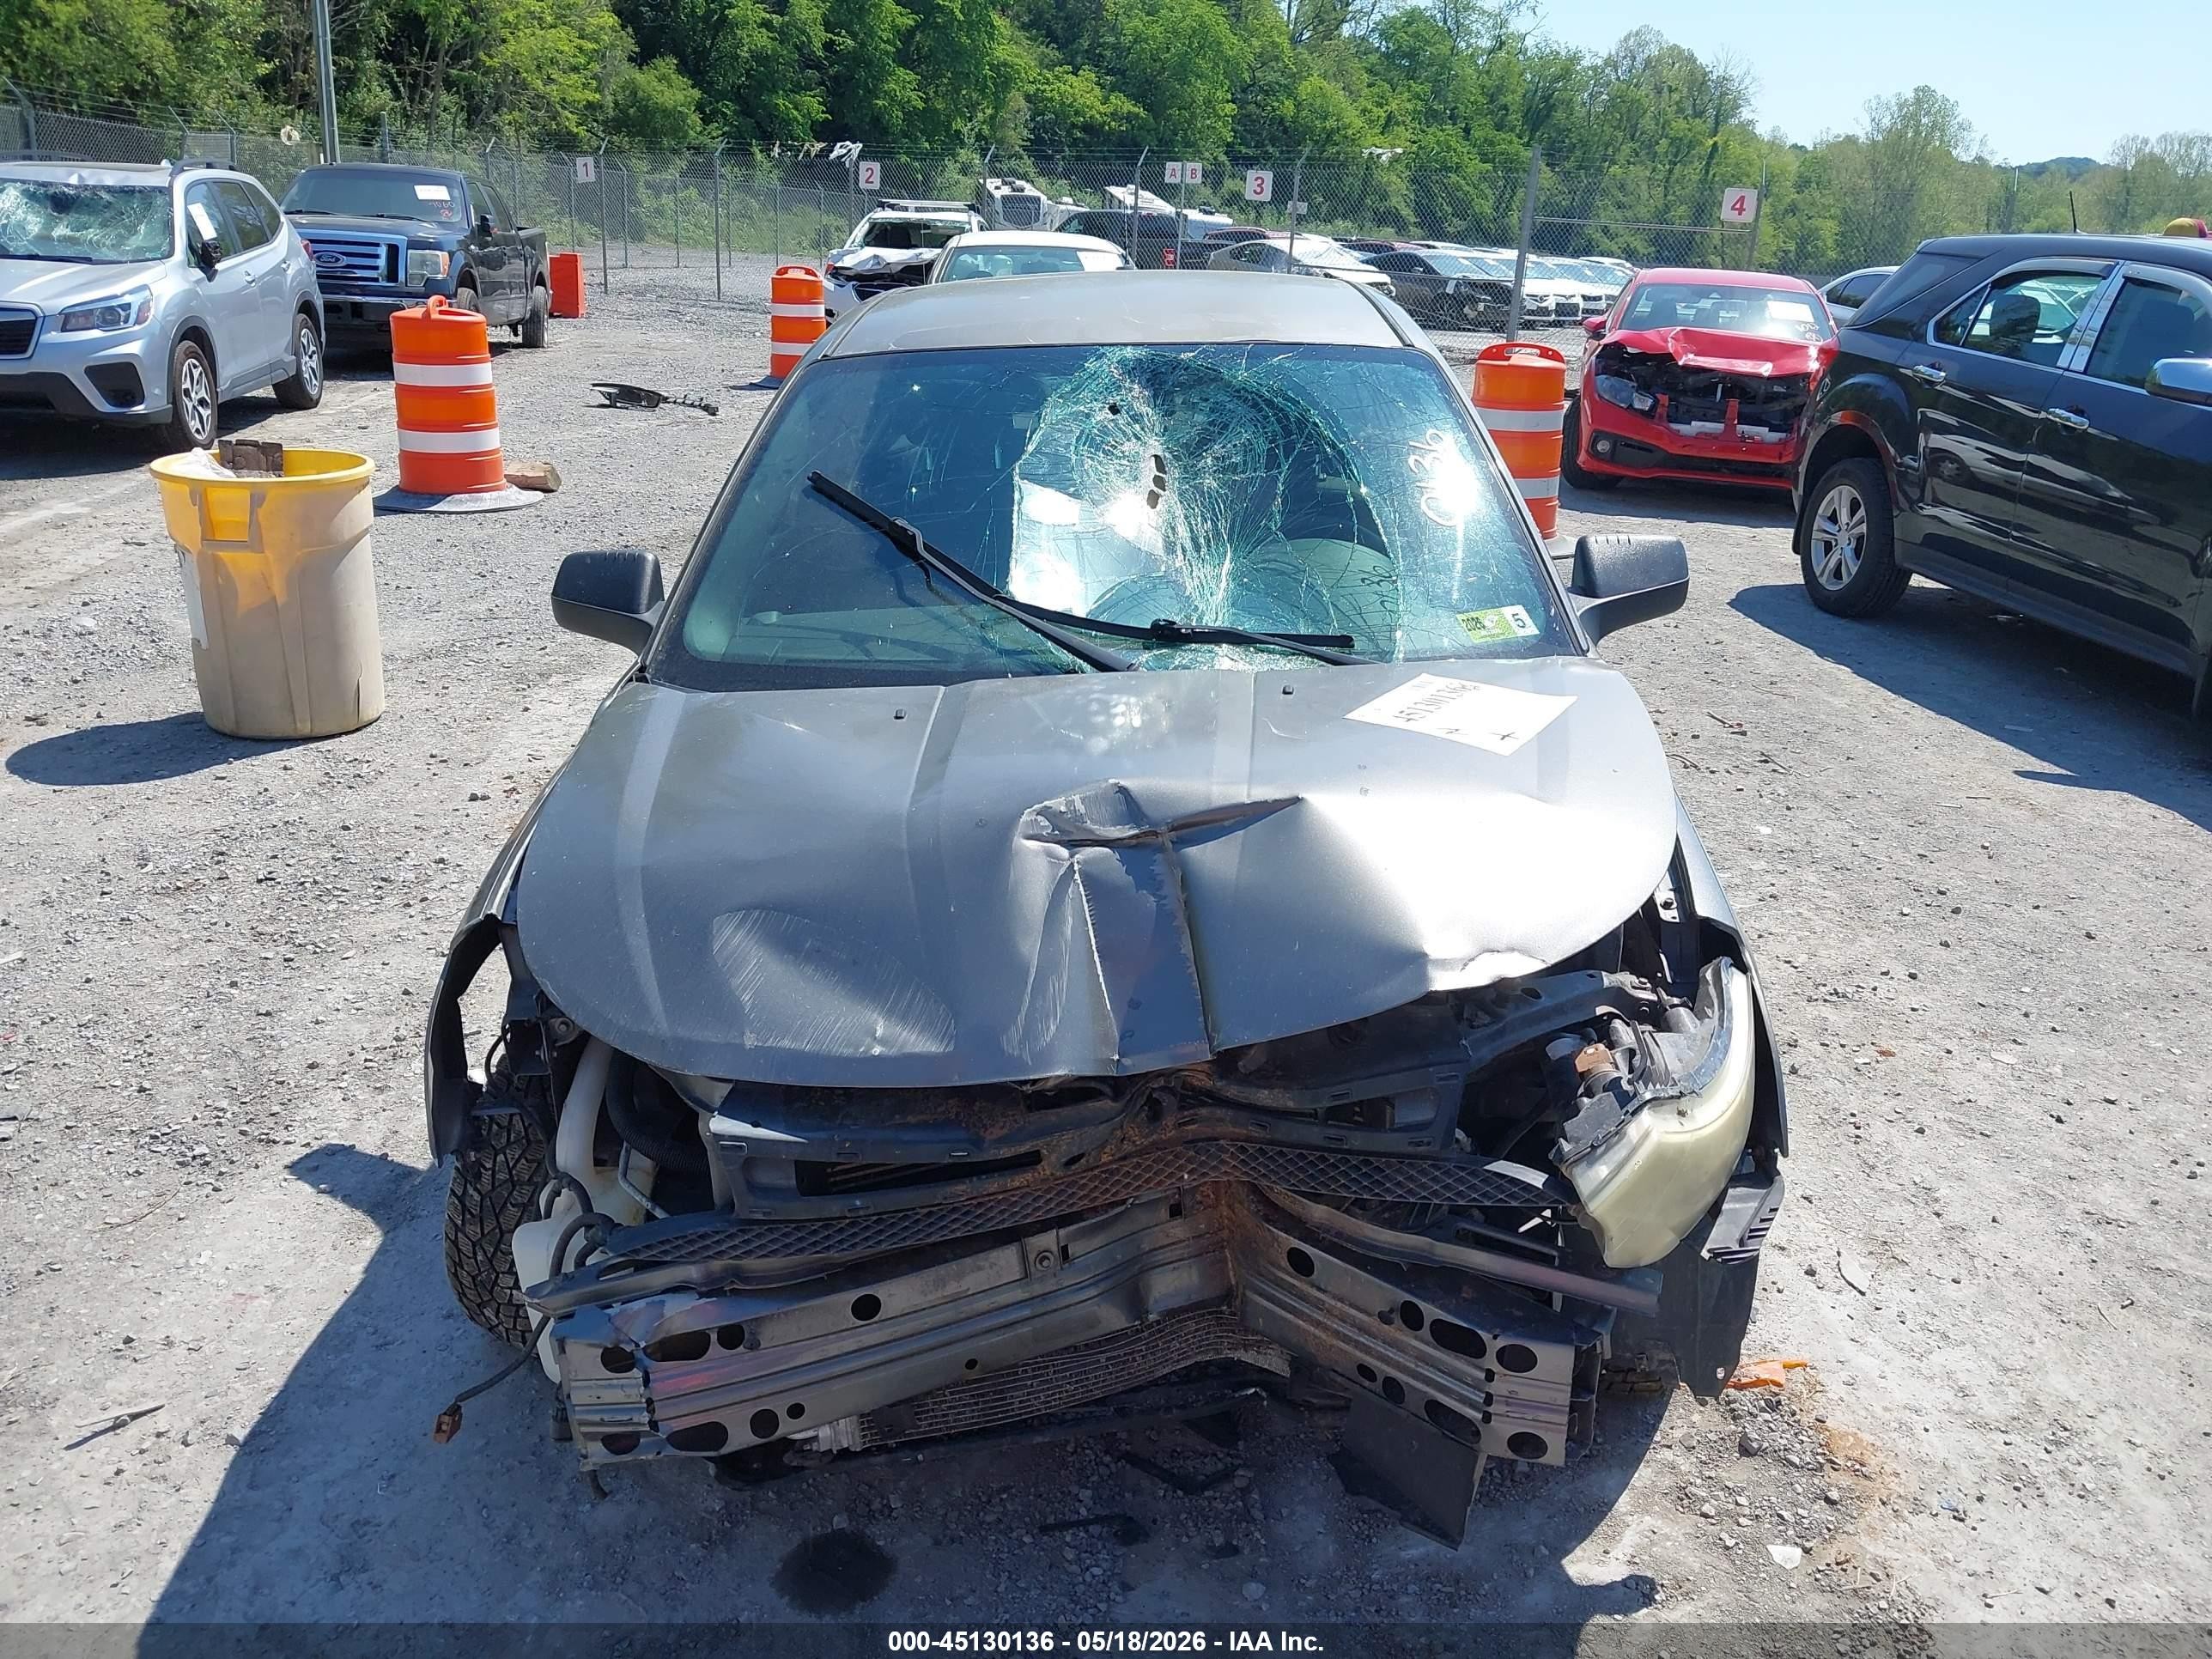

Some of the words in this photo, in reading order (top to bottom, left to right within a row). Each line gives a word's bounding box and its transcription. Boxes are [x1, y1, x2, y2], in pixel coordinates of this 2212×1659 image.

[582, 161, 589, 178] 1
[865, 167, 874, 185] 2
[1169, 167, 1177, 179] A
[1190, 167, 1198, 179] B
[1252, 176, 1265, 196] 3
[1730, 195, 1746, 216] 4
[1510, 612, 1527, 629] 5
